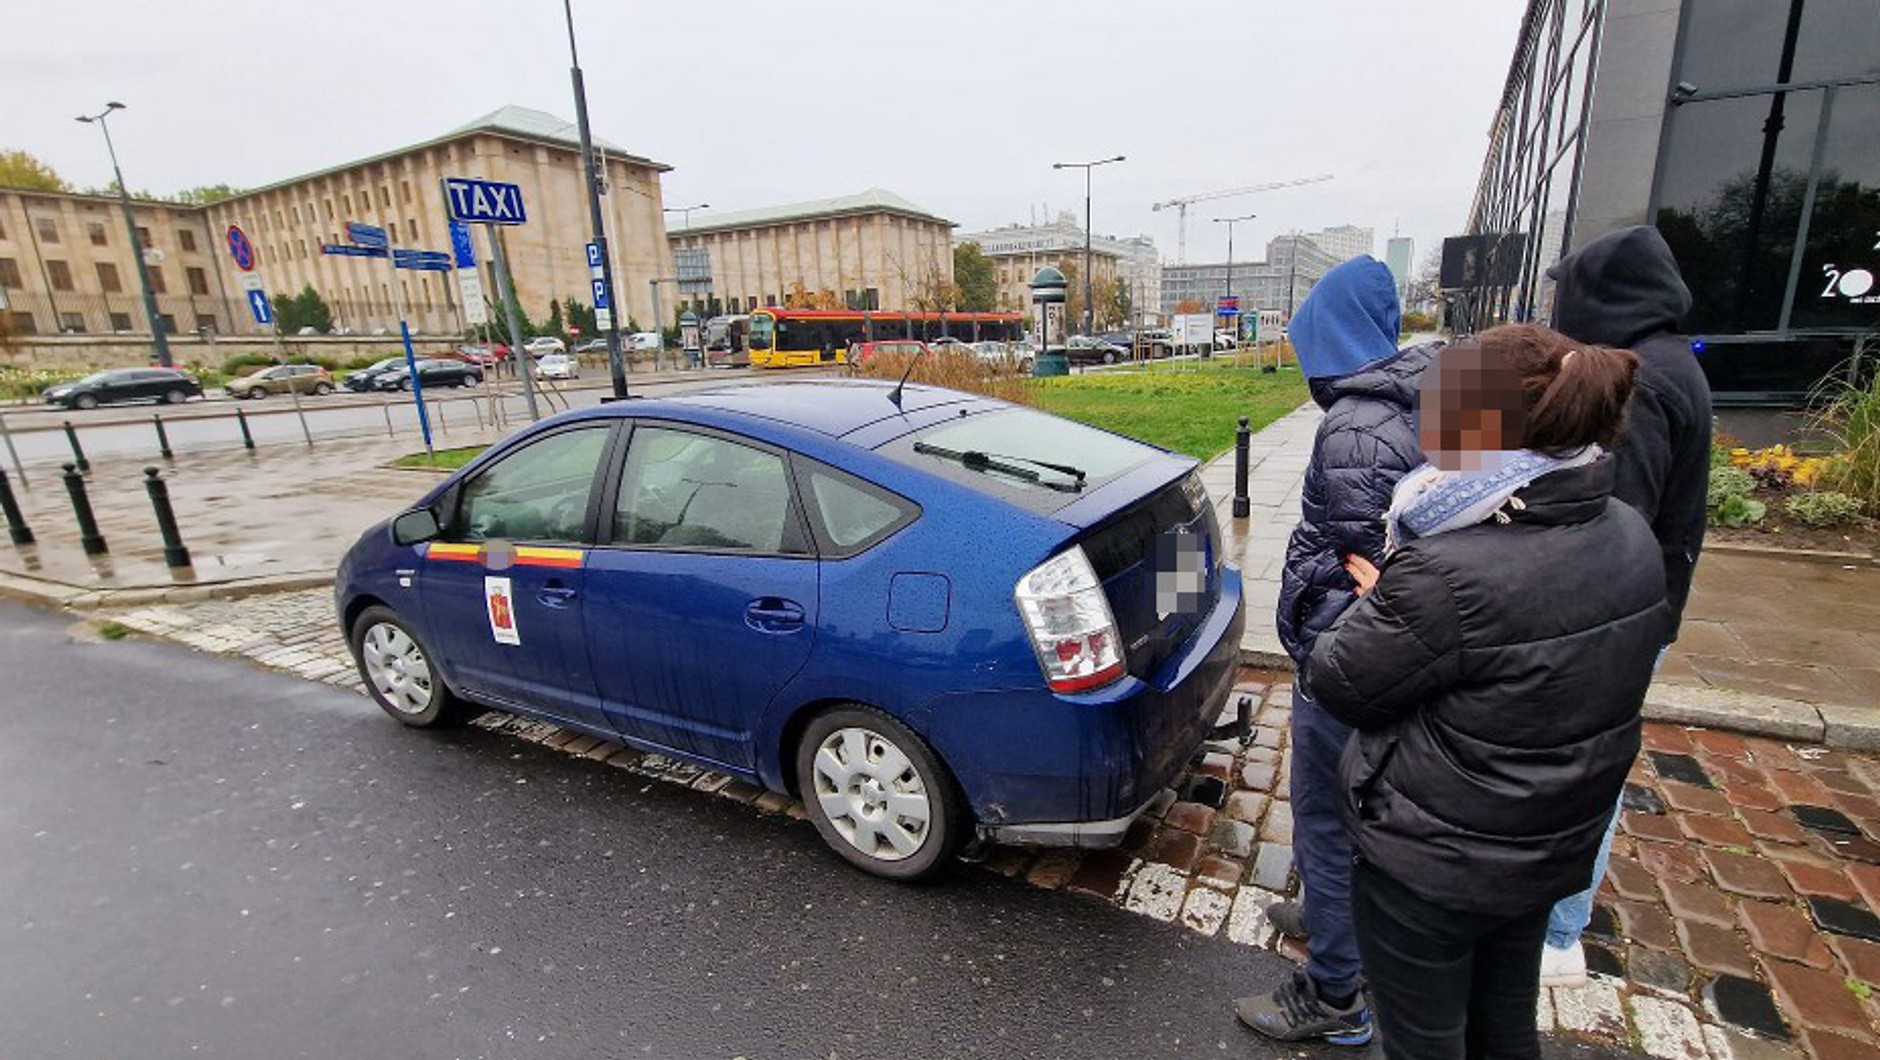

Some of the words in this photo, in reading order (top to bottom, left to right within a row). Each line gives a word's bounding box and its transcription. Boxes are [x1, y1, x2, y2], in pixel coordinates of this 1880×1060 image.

[449, 183, 520, 218] TAXI
[588, 245, 598, 265] P
[594, 281, 604, 301] P
